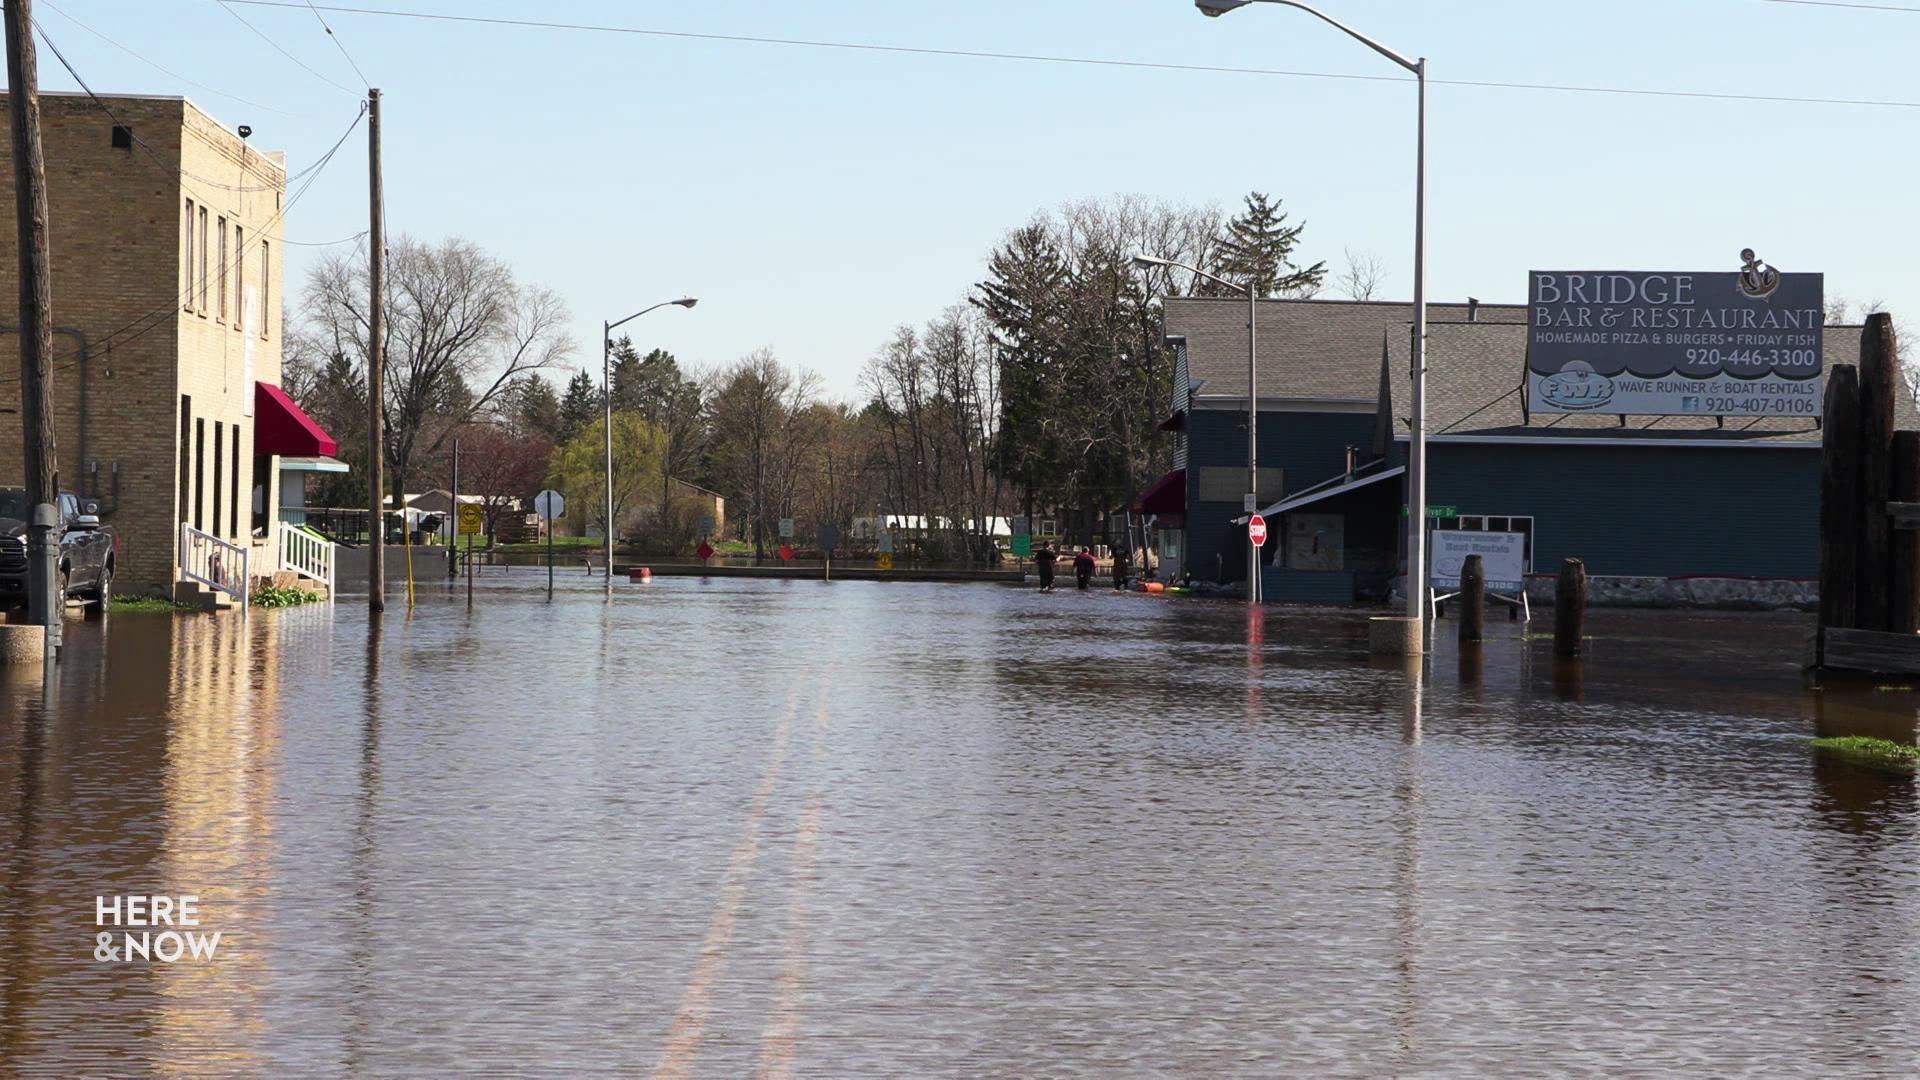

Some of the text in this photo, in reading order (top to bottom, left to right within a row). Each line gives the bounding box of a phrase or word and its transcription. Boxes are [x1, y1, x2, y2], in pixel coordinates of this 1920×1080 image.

[1535, 274, 1695, 305] BRIDGE
[1535, 307, 1818, 329] BAR & RESTAURANT
[1535, 332, 1816, 346] HOMEMADE PIZZA & BURGERS FRIDAY FISH
[1686, 349, 1815, 366] 920-446-3300
[1619, 381, 1815, 395] WAVE RUNNER & BOAT RENTALS
[1705, 397, 1814, 413] 920-407-0106
[1250, 525, 1265, 537] STOP
